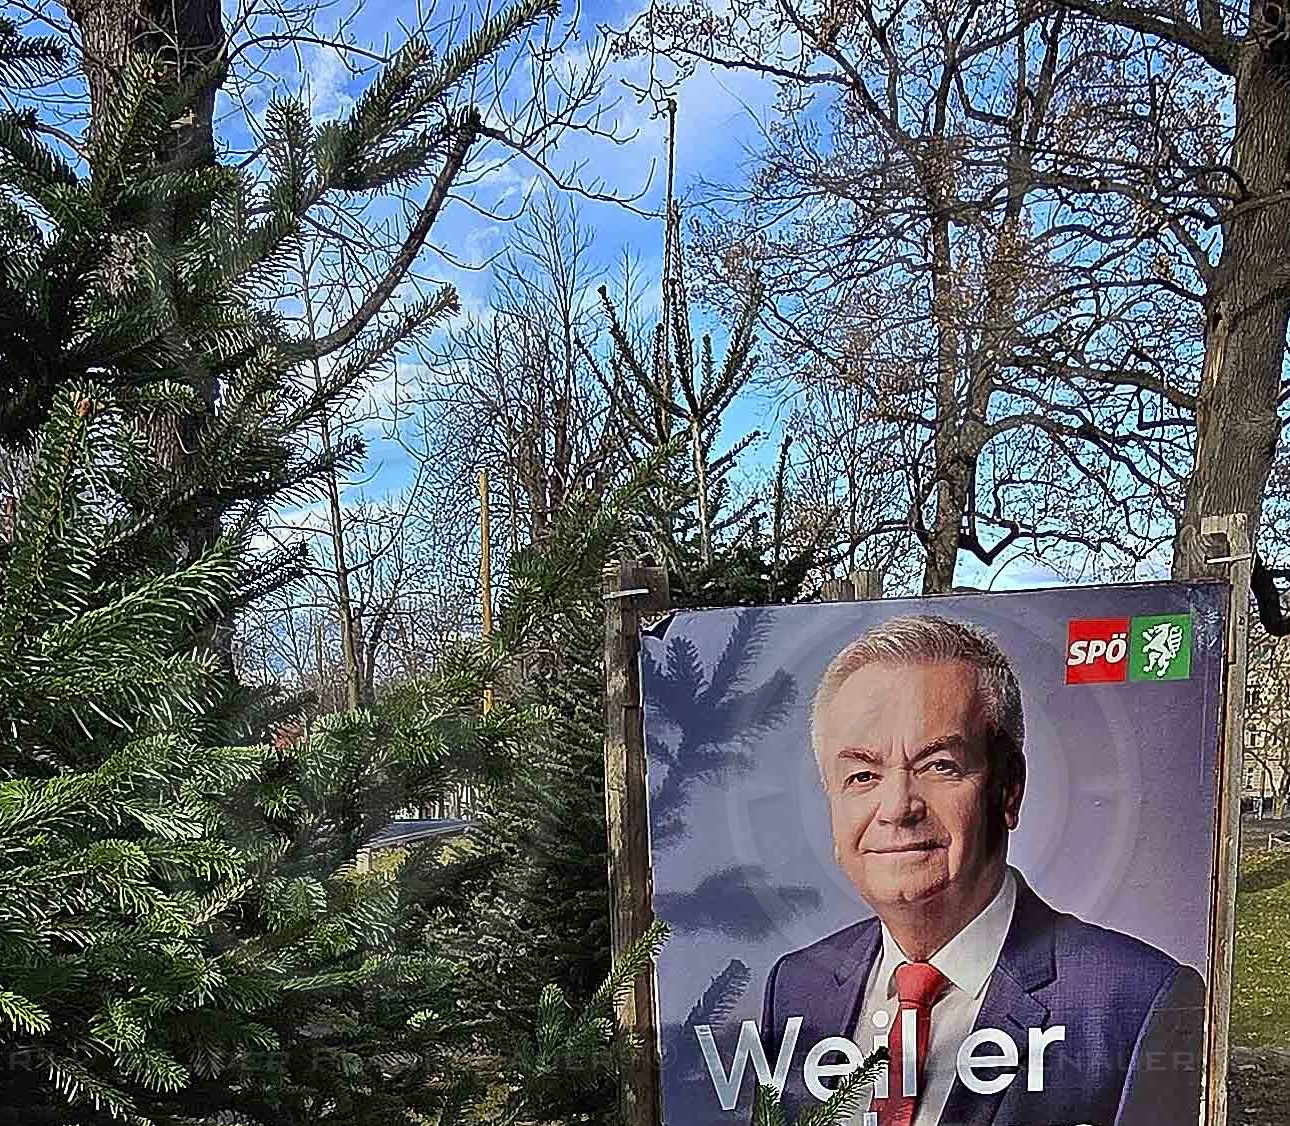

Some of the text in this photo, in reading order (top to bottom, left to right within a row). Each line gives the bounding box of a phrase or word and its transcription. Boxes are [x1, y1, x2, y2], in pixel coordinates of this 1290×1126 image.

[1067, 633, 1127, 666] SPÖ
[693, 1008, 1067, 1111] Weil er
